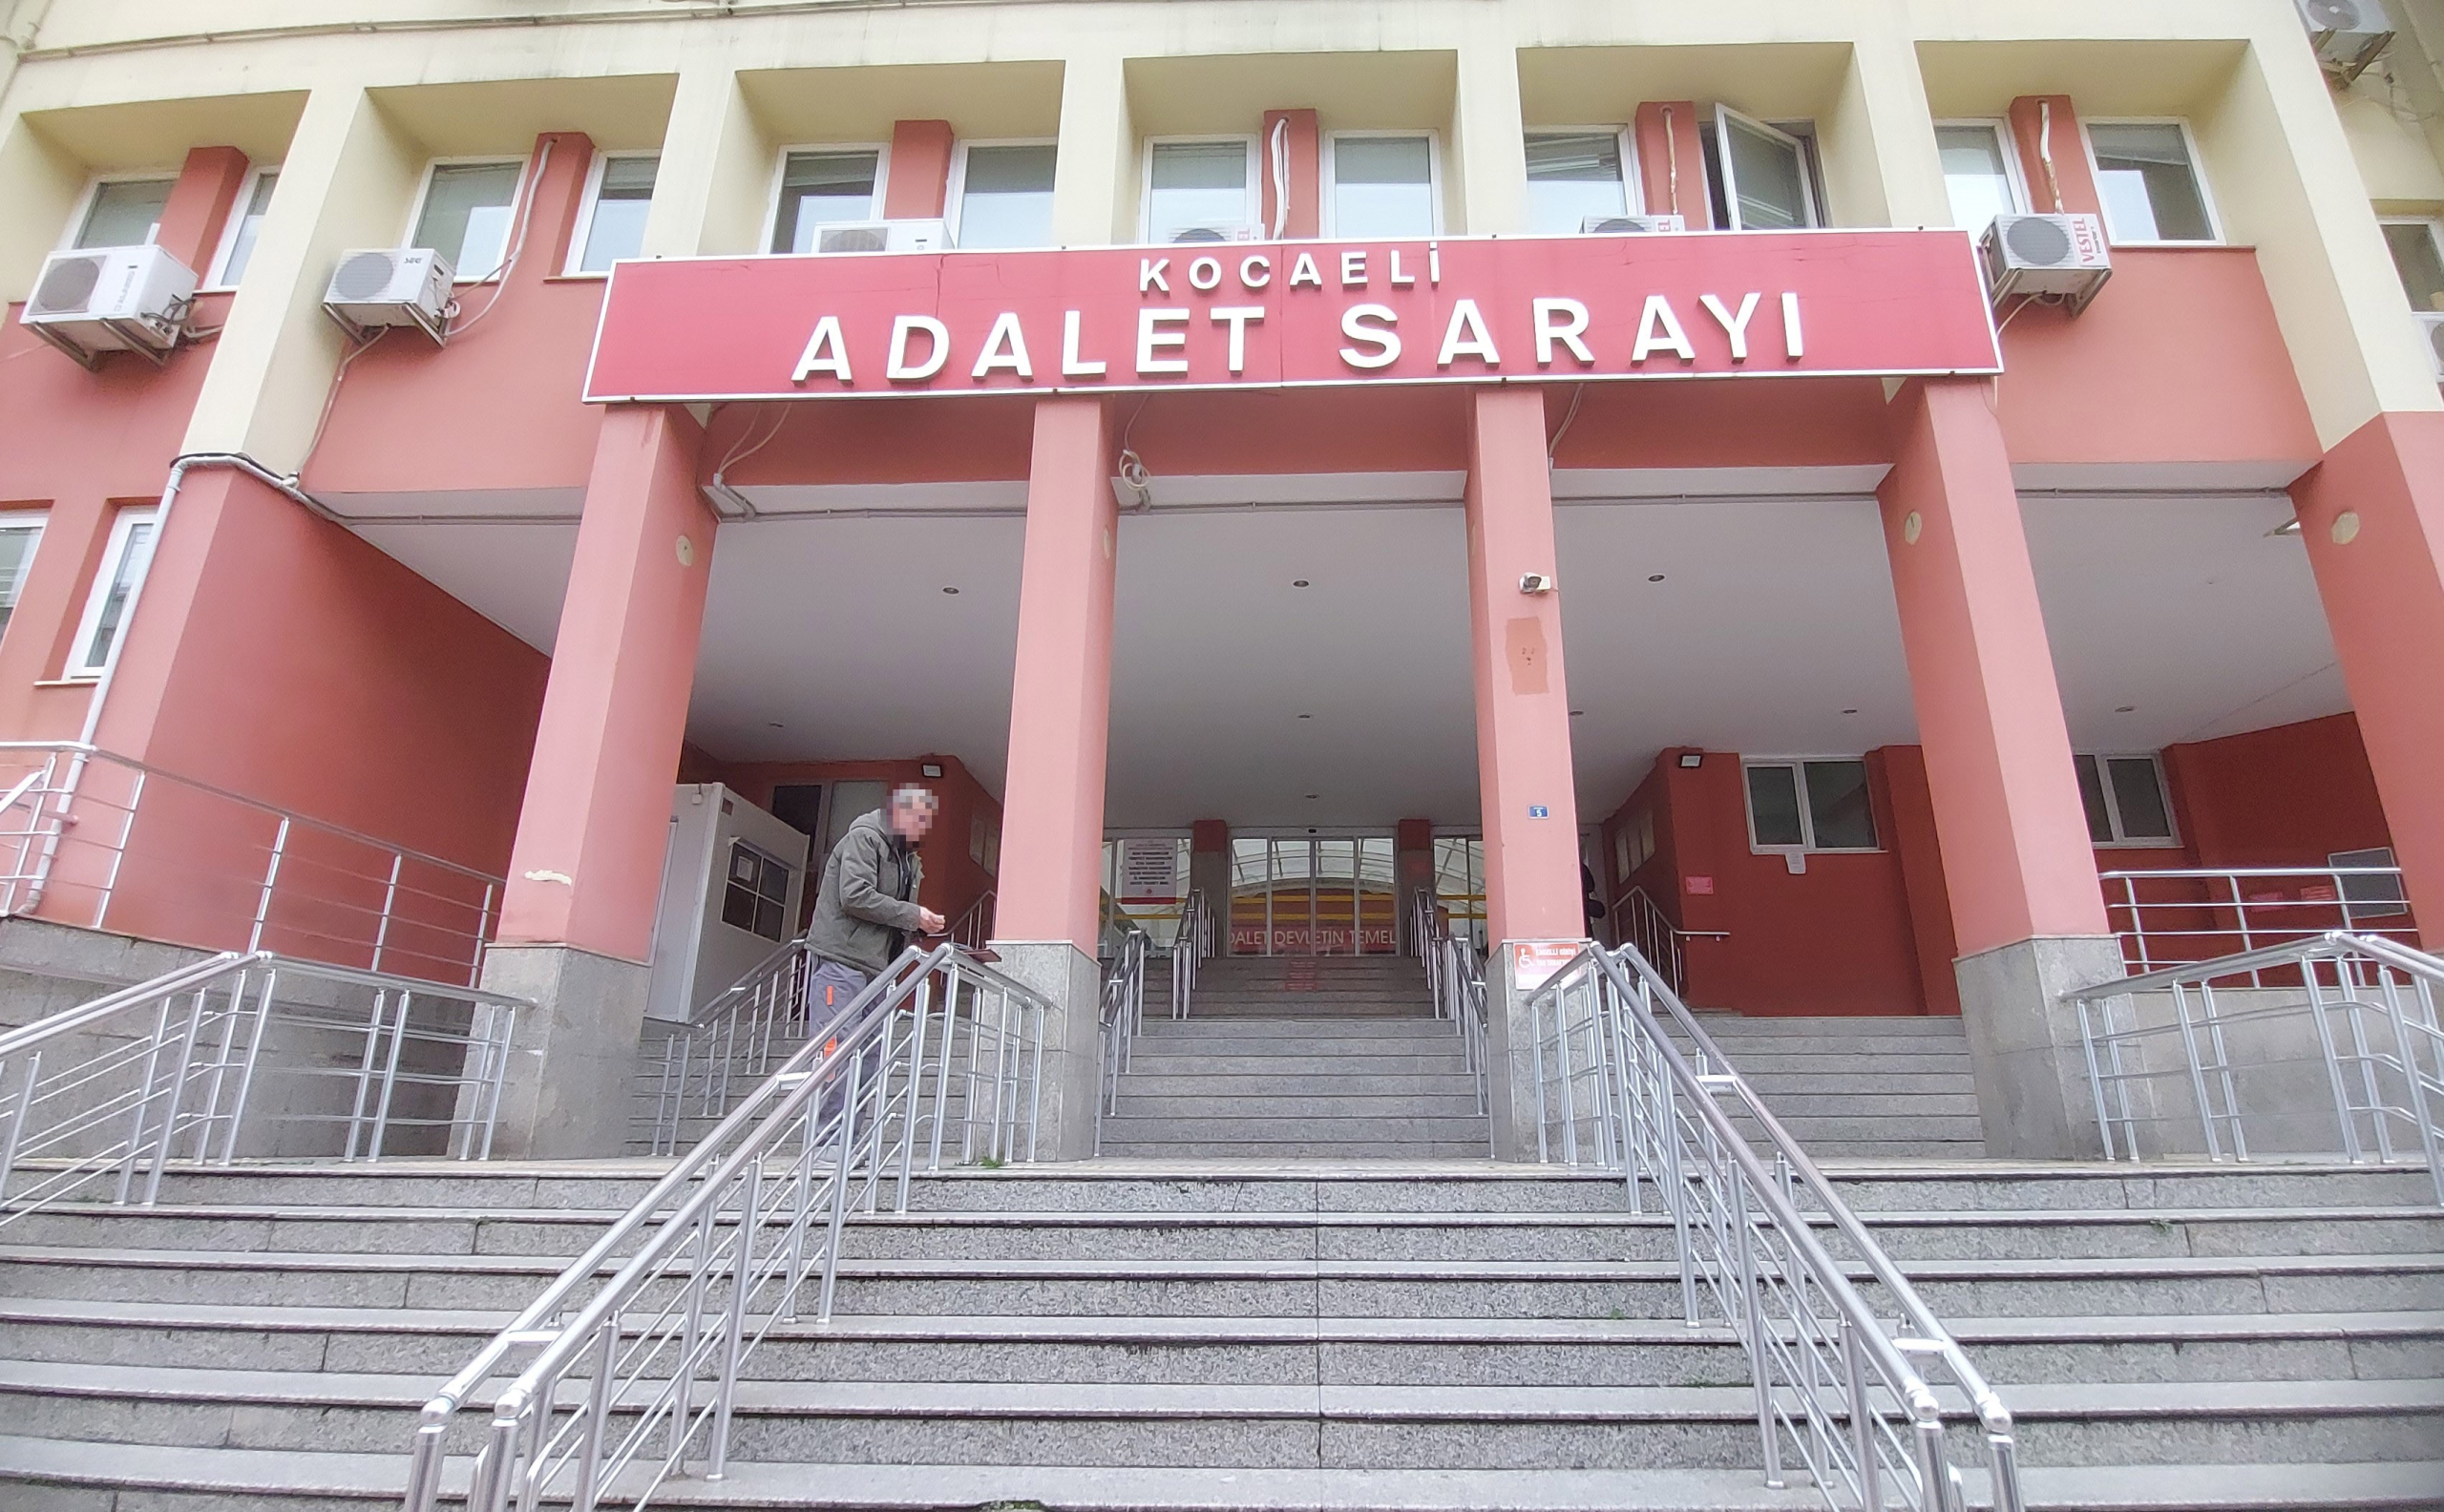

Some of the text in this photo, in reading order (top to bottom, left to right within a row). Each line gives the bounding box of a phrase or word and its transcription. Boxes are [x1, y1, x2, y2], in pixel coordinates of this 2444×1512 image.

[2072, 218, 2095, 262] VESTEL
[1137, 242, 1443, 295] KOCAELİ
[790, 291, 1804, 386] ADALET SARAYI
